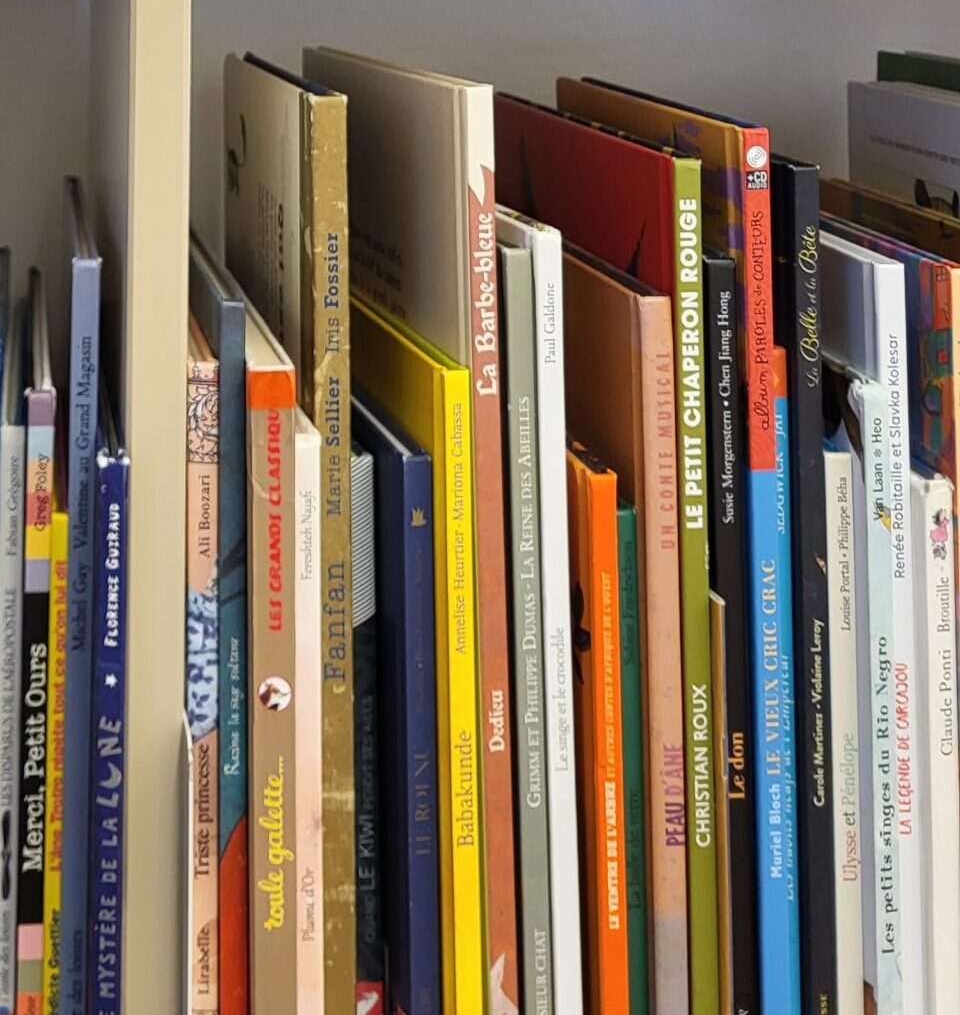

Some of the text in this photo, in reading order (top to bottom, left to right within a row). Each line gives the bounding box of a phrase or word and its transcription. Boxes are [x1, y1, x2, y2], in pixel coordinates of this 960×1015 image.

[473, 212, 497, 396] La Barbe-bleue
[679, 199, 704, 529] LE PETIT CHAPERON ROUGE
[324, 232, 346, 682] Fanfan Marie Sellier Iris Fossier
[716, 291, 738, 523] Susie Morgenstern Chen Jiang Hong
[886, 334, 906, 579] Renée Robitaille et Slavka Kolesar
[198, 474, 212, 558] Ali Boozari
[22, 642, 48, 873] Merci, Petit Ours
[454, 730, 476, 848] Babakunde
[488, 689, 506, 753] Dedieu
[691, 683, 712, 848] CHRISTIAN ROUX
[729, 732, 745, 800] Le don
[761, 559, 783, 879] Muriel Bloch LE VIEUX CRIC CRAC
[840, 733, 861, 883] Ulysse et Pénélope
[875, 637, 898, 954] Les petits singes du Rio Negro
[194, 743, 213, 880] Triste princesse
[95, 817, 120, 999] MYSTÈRE DE LA
